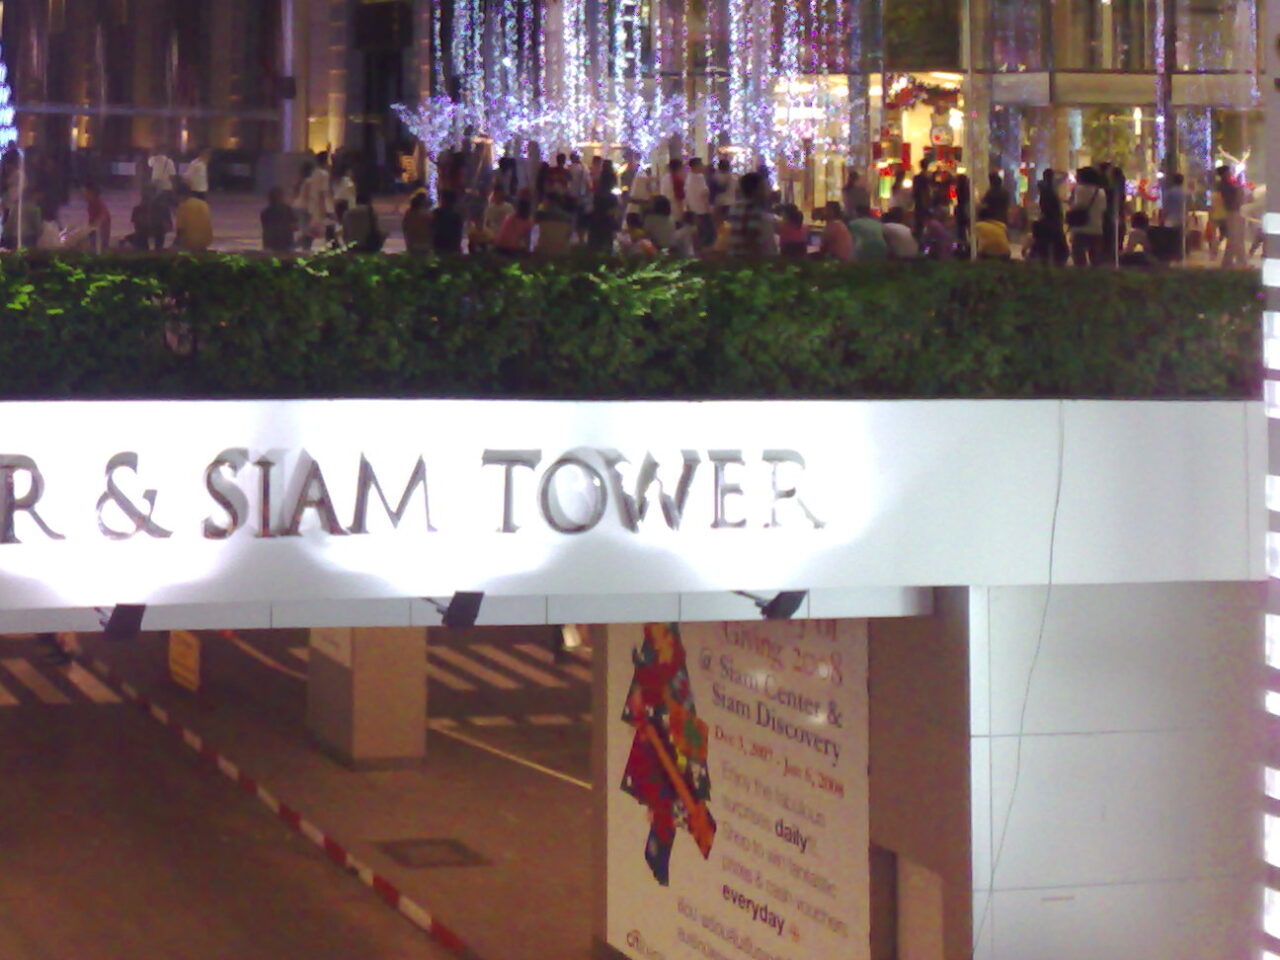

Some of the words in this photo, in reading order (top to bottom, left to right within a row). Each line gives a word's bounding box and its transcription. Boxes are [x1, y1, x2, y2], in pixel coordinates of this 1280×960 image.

[96, 450, 173, 542] &
[201, 446, 437, 540] SIAM
[481, 445, 826, 536] TOWER
[712, 682, 750, 719] Siam
[756, 701, 839, 767] Discovery
[720, 654, 758, 690] Siam
[765, 675, 819, 716] Center
[827, 700, 842, 728] &
[775, 818, 808, 854] daily
[722, 884, 785, 936] everyday
